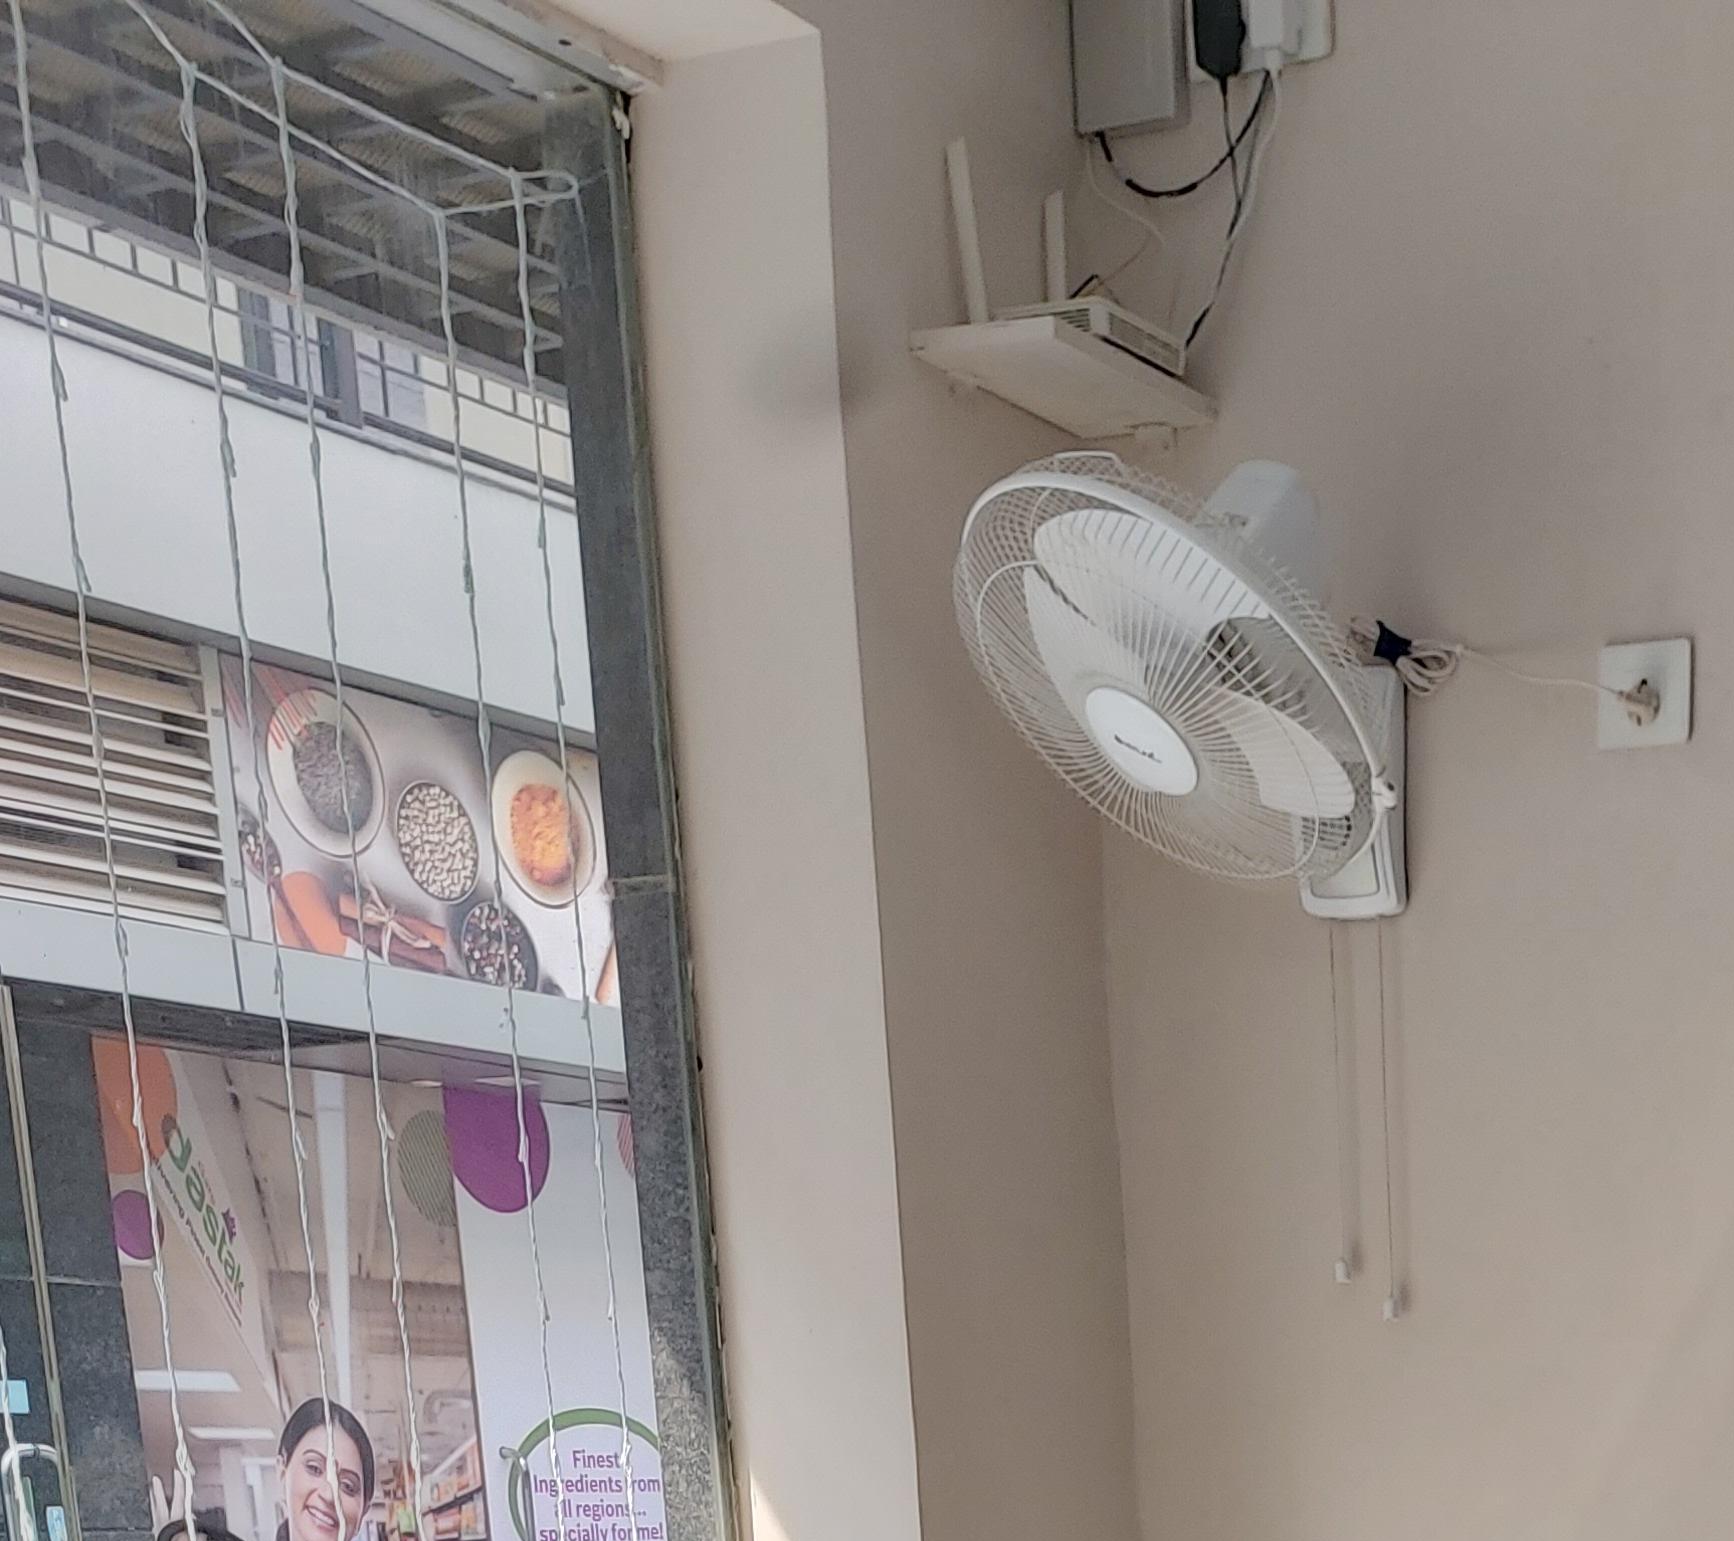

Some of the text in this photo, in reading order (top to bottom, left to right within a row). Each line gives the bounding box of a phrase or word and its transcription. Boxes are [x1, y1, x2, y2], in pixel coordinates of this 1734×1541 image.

[572, 1449, 620, 1469] Finest
[533, 1474, 661, 1498] Ingedients rom
[612, 1523, 633, 1541] for
[636, 1522, 664, 1540] me!
